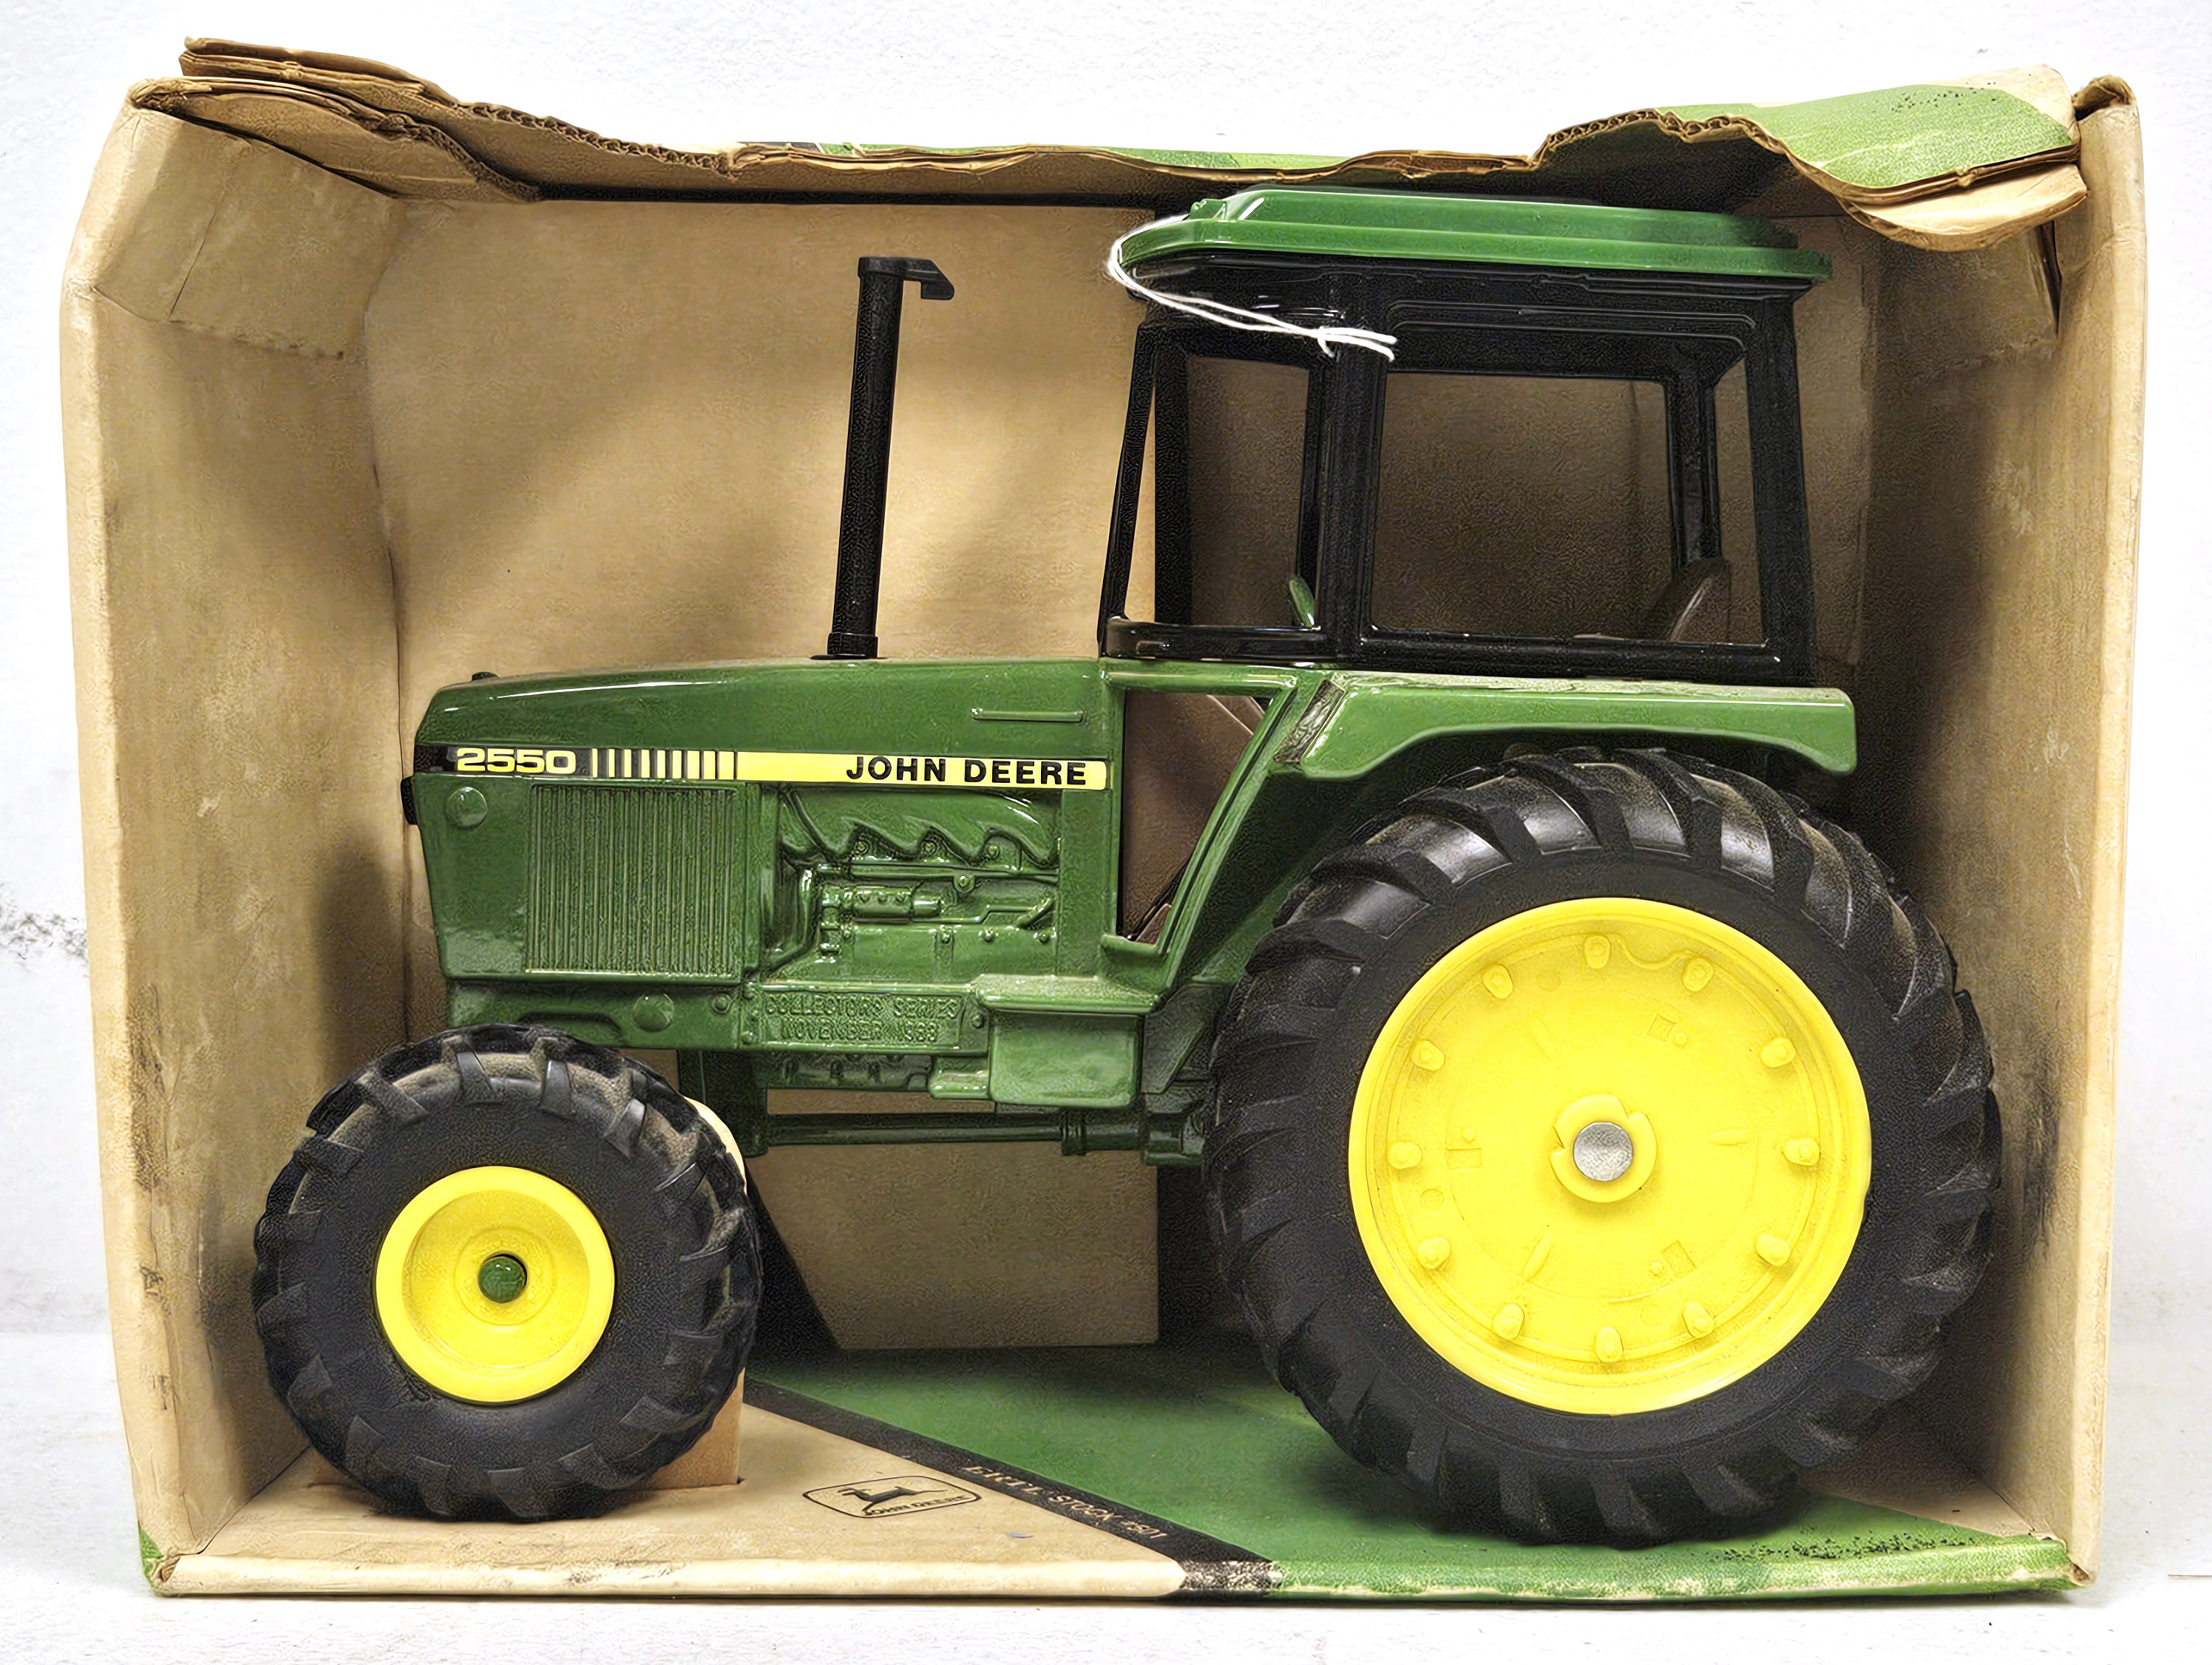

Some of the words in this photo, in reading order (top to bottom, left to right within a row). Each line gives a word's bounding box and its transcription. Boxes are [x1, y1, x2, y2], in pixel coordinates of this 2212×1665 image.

[456, 747, 577, 774] 2550
[846, 756, 946, 782] JOHN
[963, 759, 1086, 785] DEERE
[764, 994, 884, 1017] COLLECTORS
[893, 997, 958, 1020] SERIES
[1048, 1494, 1123, 1522] STOCK
